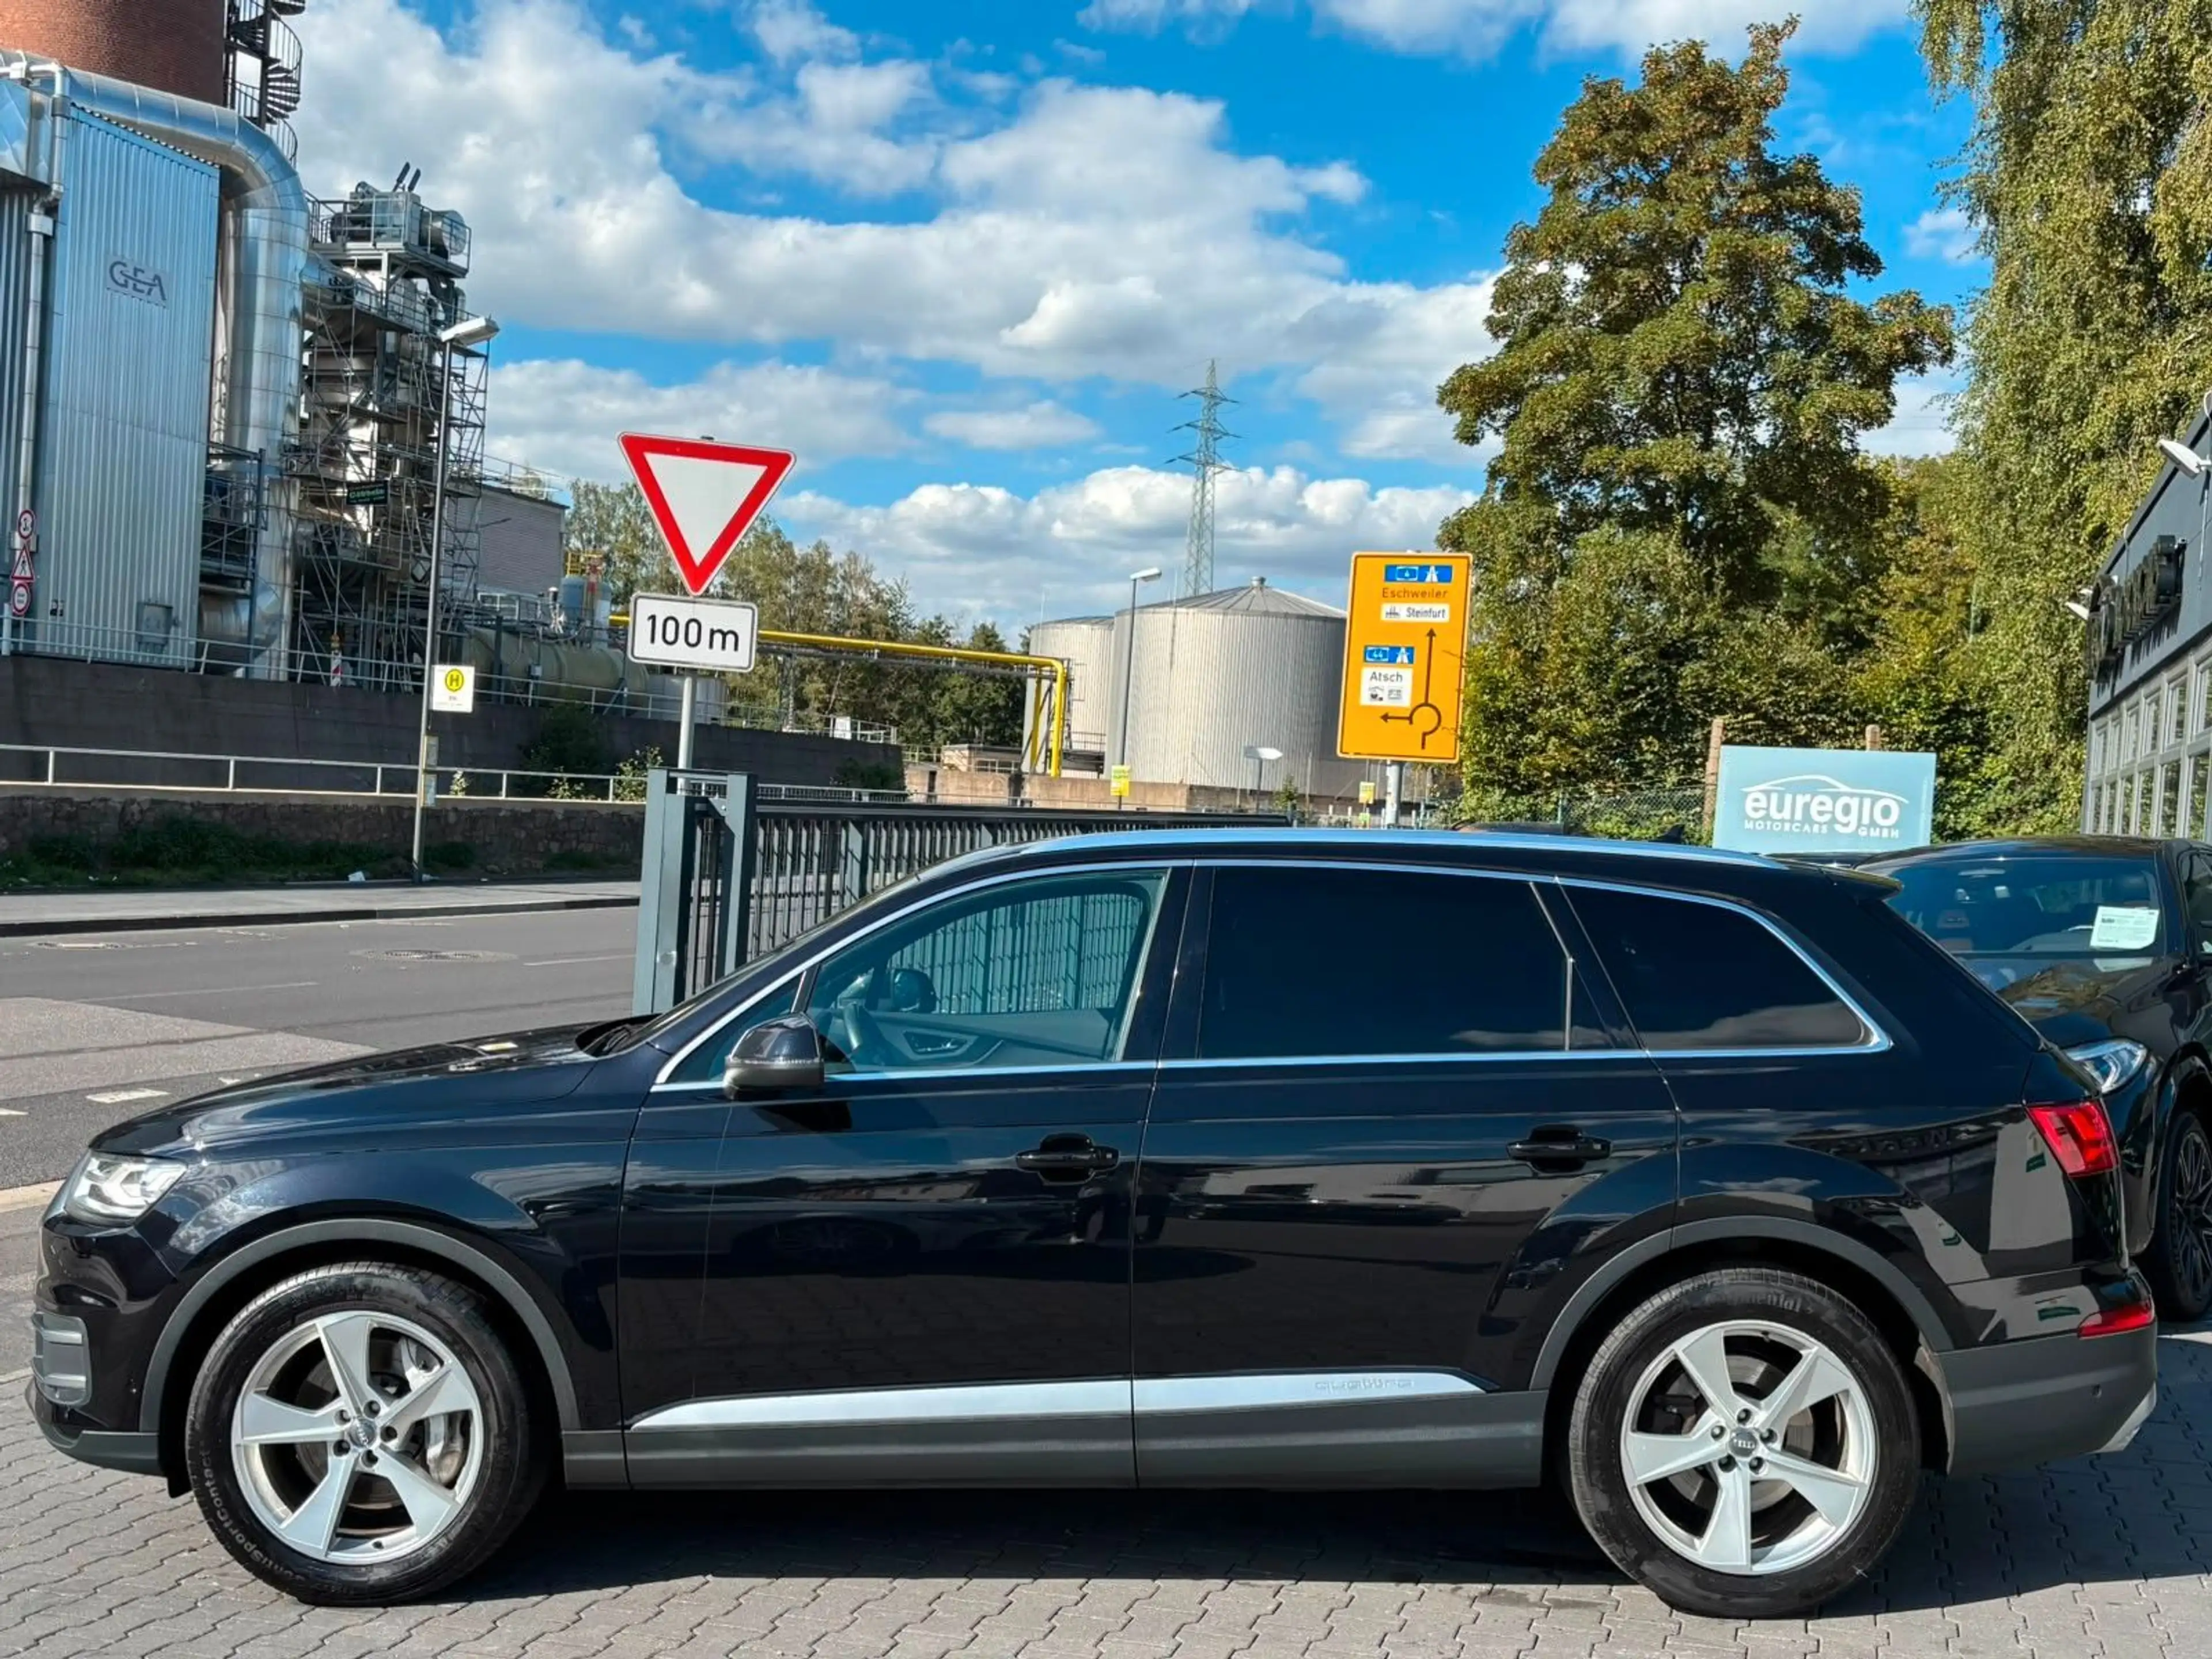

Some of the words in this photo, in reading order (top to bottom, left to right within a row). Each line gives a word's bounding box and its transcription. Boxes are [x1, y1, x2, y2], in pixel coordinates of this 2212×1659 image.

[109, 261, 166, 300] GEA
[1382, 587, 1448, 599] Eschweiler
[1406, 606, 1446, 618] Steinfurt
[449, 674, 460, 687] H
[1370, 671, 1403, 683] Atsch
[1744, 791, 1900, 834] euregio
[1744, 819, 1828, 834] MOTORCARS
[1857, 827, 1900, 839] GMBH
